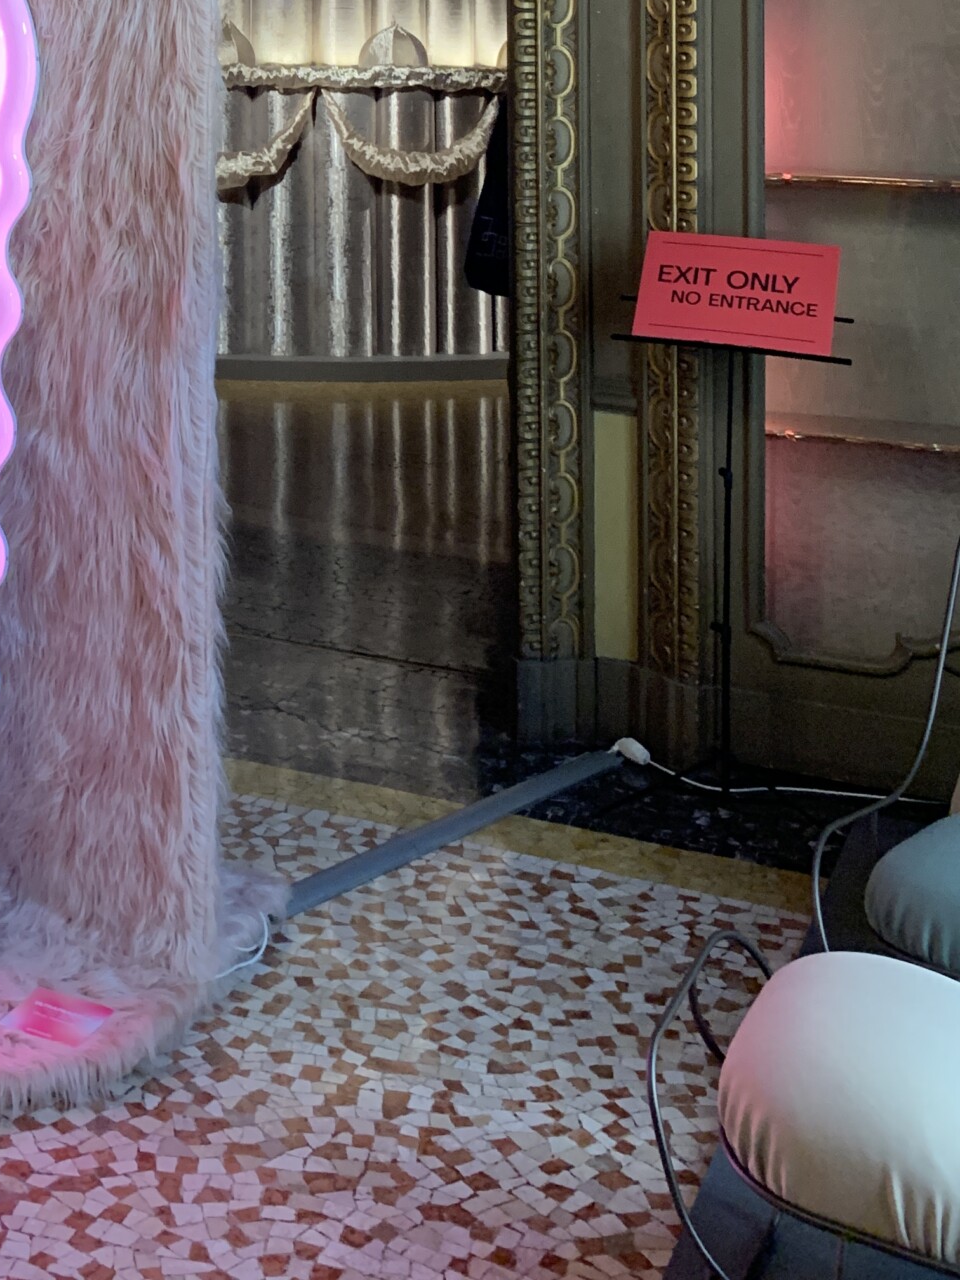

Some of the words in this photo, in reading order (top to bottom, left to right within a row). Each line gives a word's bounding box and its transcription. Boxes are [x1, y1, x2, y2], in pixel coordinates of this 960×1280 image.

[657, 264, 717, 287] EXIT
[726, 270, 800, 295] ONLY
[670, 289, 702, 306] NO
[708, 293, 819, 318] ENTRANCE
